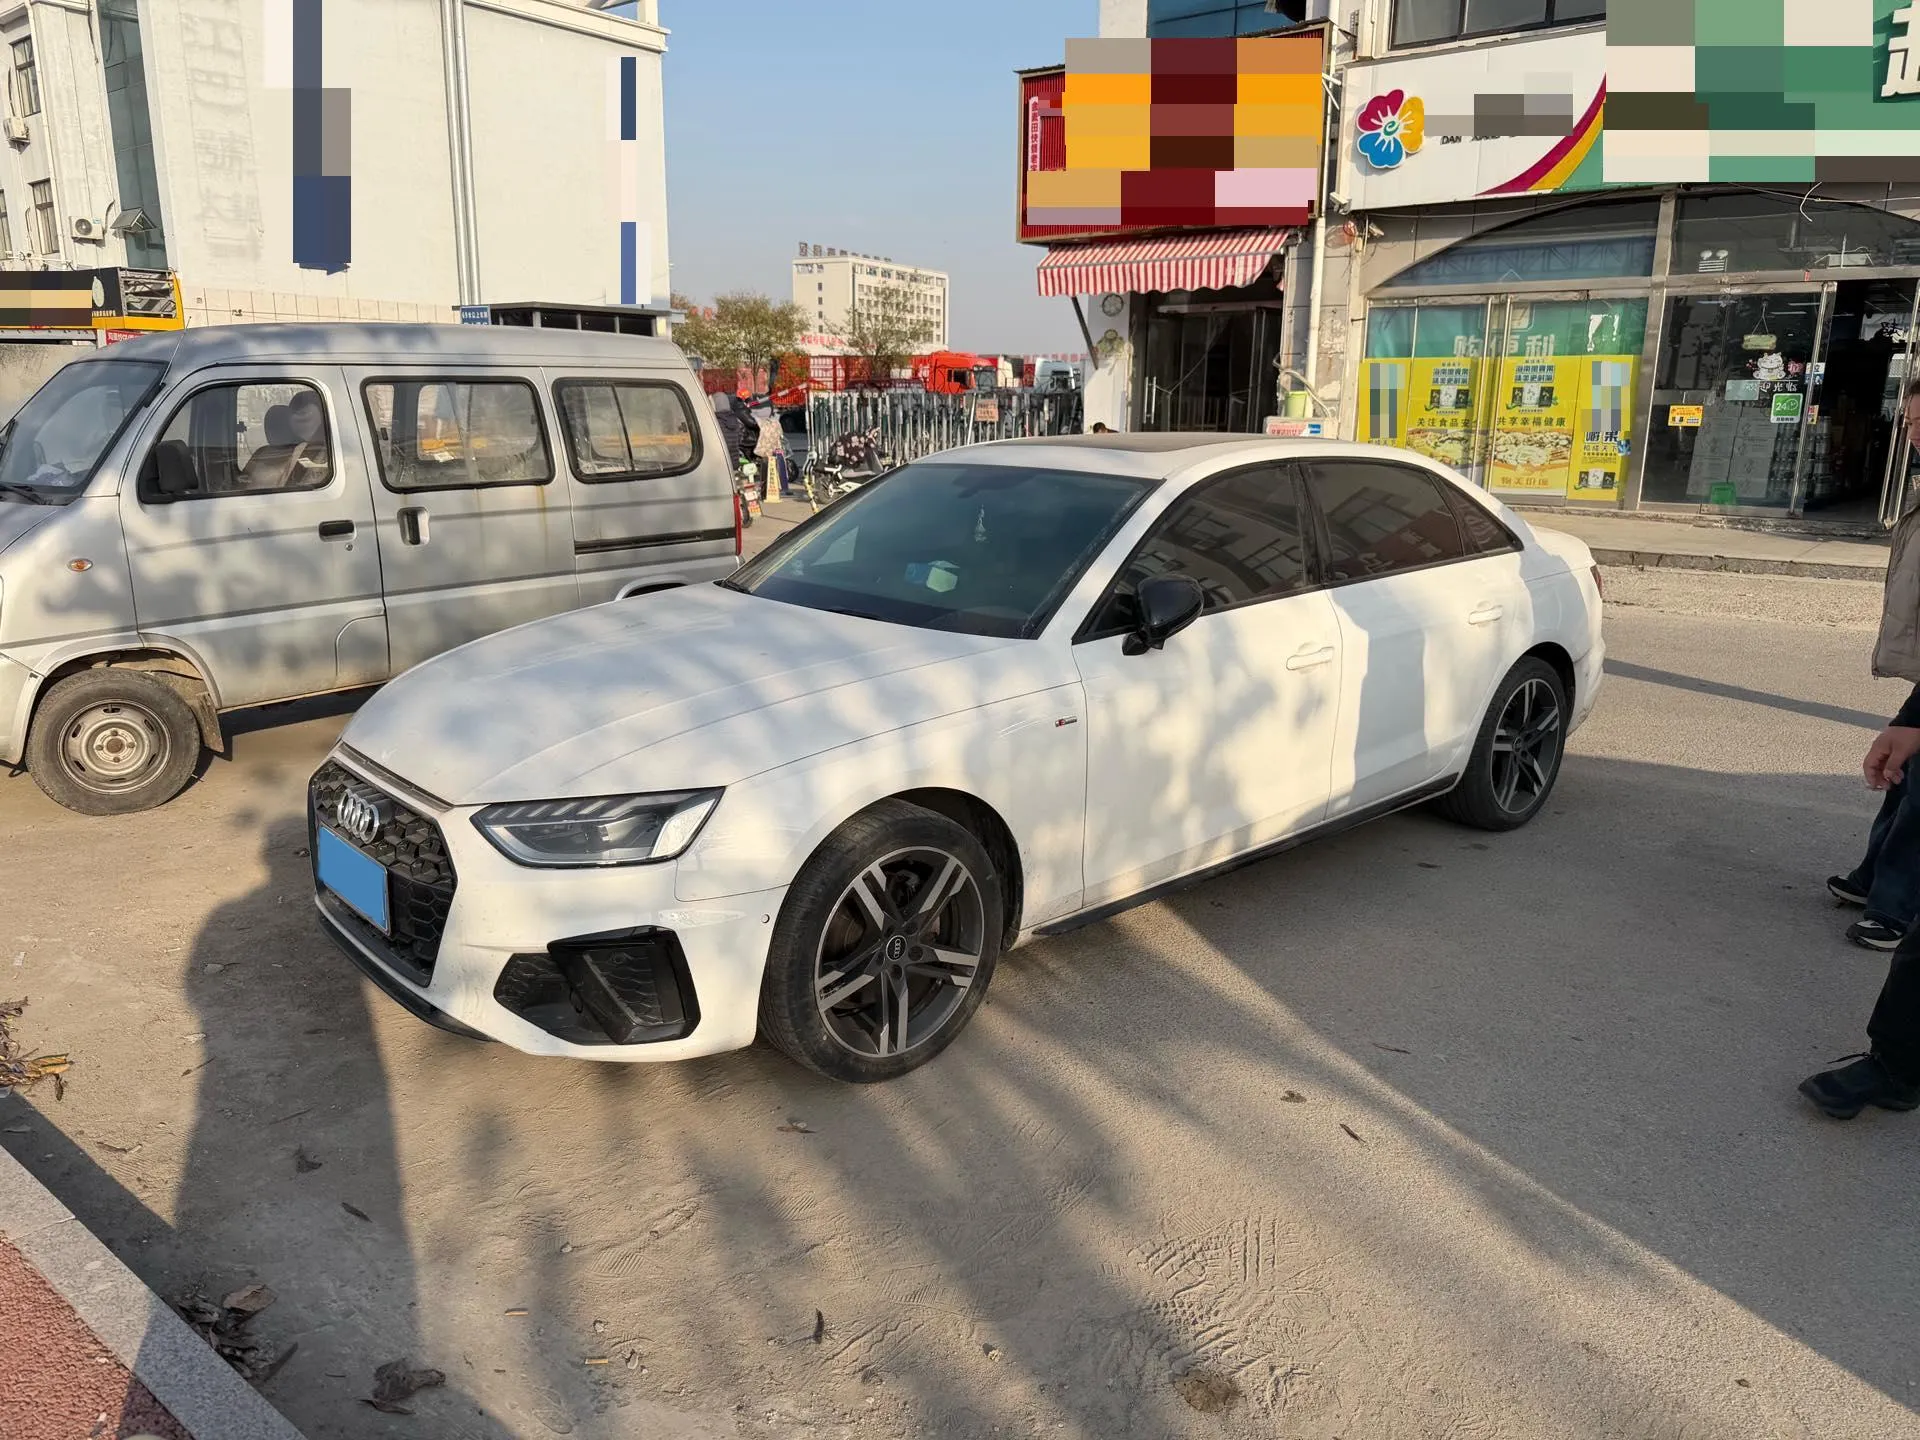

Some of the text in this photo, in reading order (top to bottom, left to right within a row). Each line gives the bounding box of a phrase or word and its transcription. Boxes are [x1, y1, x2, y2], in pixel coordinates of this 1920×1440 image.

[1497, 416, 1566, 427] 共享幸福健康
